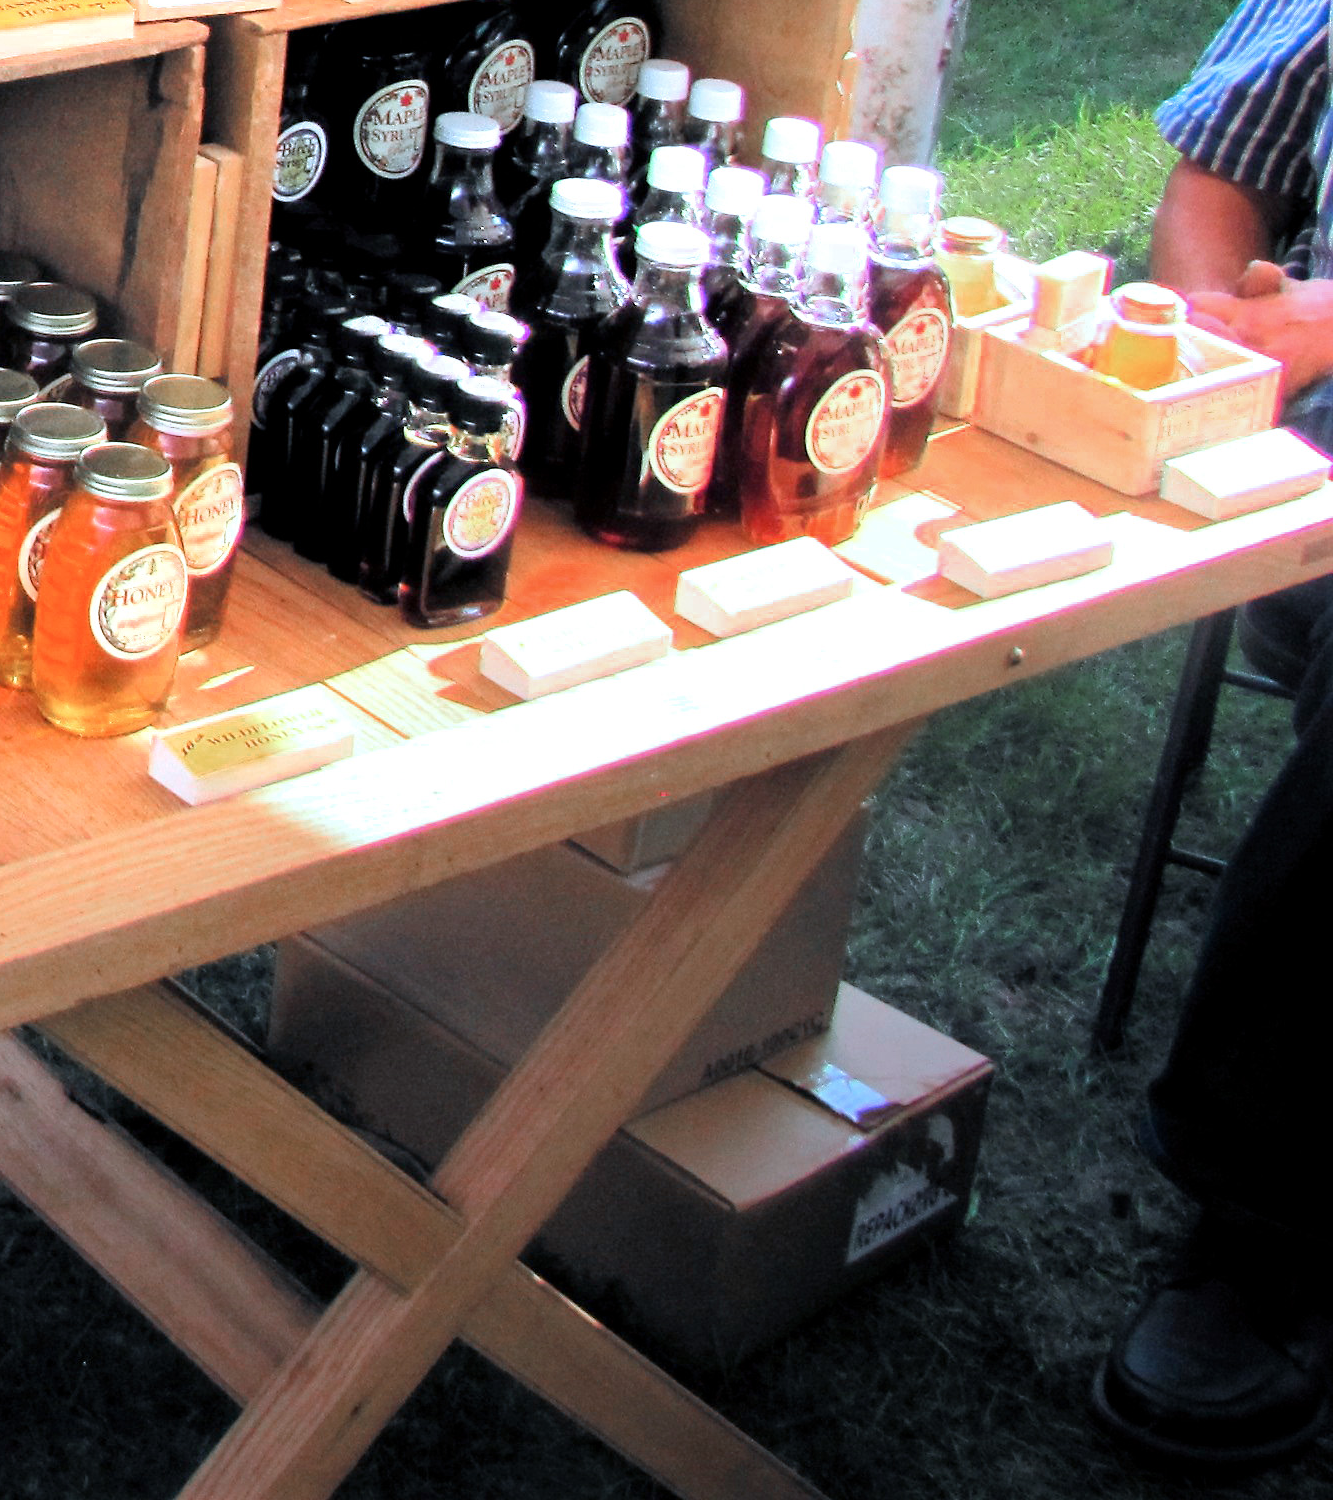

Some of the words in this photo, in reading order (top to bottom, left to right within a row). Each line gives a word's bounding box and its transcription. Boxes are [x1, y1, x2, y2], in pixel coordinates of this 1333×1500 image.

[18, 2, 81, 19] HONEY
[372, 107, 425, 126] MAPLE
[113, 583, 177, 607] HONEY
